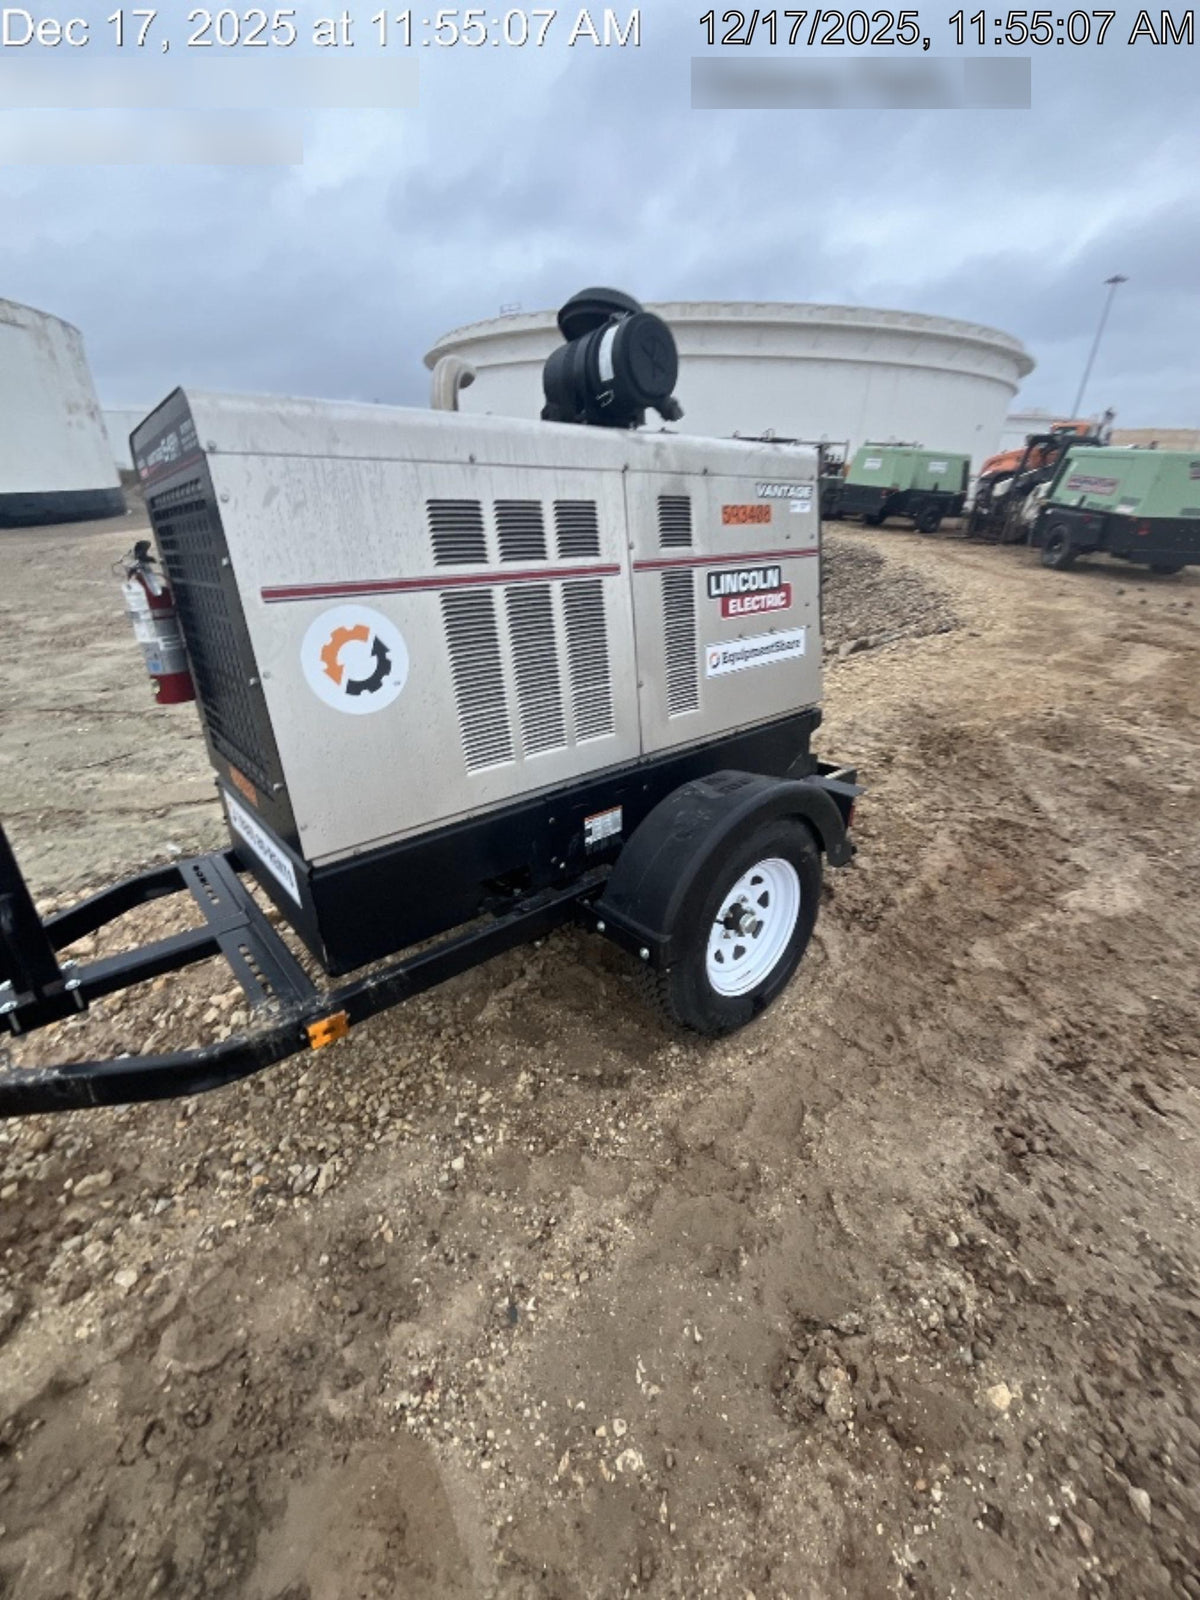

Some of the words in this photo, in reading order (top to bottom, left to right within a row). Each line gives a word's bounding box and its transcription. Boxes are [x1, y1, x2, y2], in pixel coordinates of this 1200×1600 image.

[756, 483, 813, 499] VANTAGE
[711, 568, 779, 595] LINCOLN
[728, 592, 787, 614] ELECTRIC
[722, 639, 801, 665] EquipmentShare
